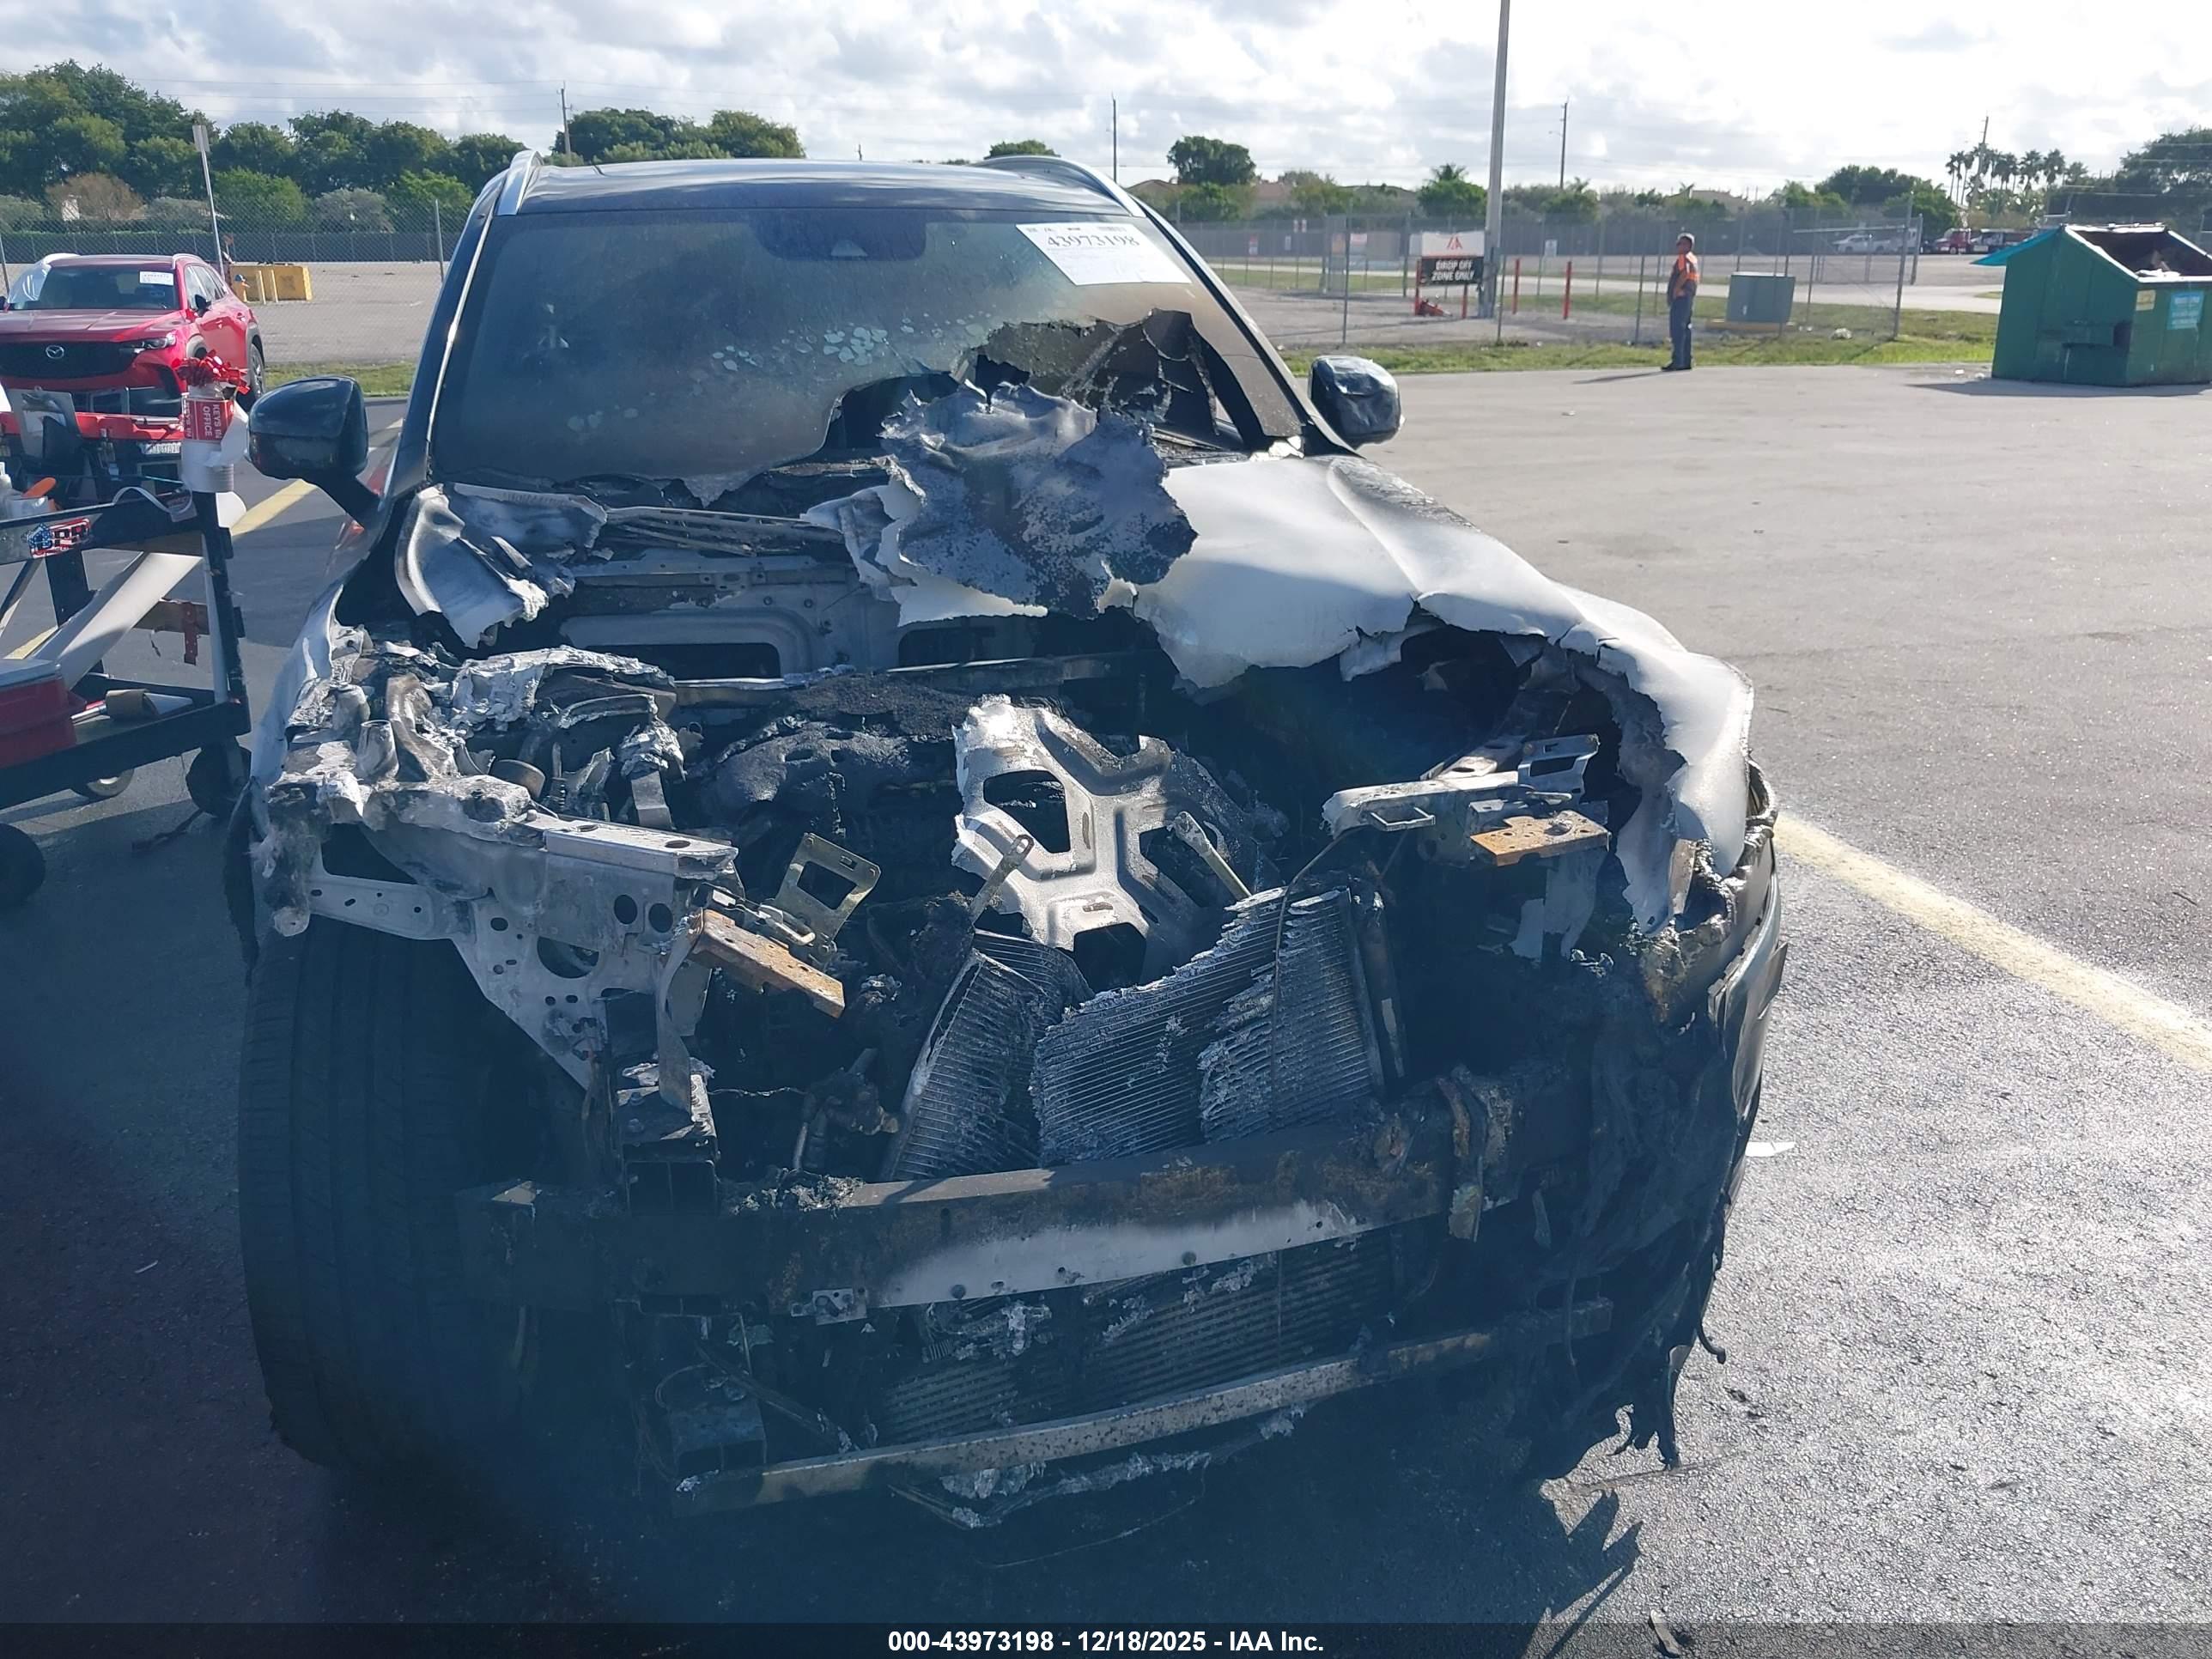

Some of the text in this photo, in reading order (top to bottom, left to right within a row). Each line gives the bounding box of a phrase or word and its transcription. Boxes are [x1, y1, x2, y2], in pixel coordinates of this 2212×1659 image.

[1048, 234, 1140, 247] 43973198
[203, 405, 213, 437] OFFICE
[212, 404, 222, 427] KEYS
